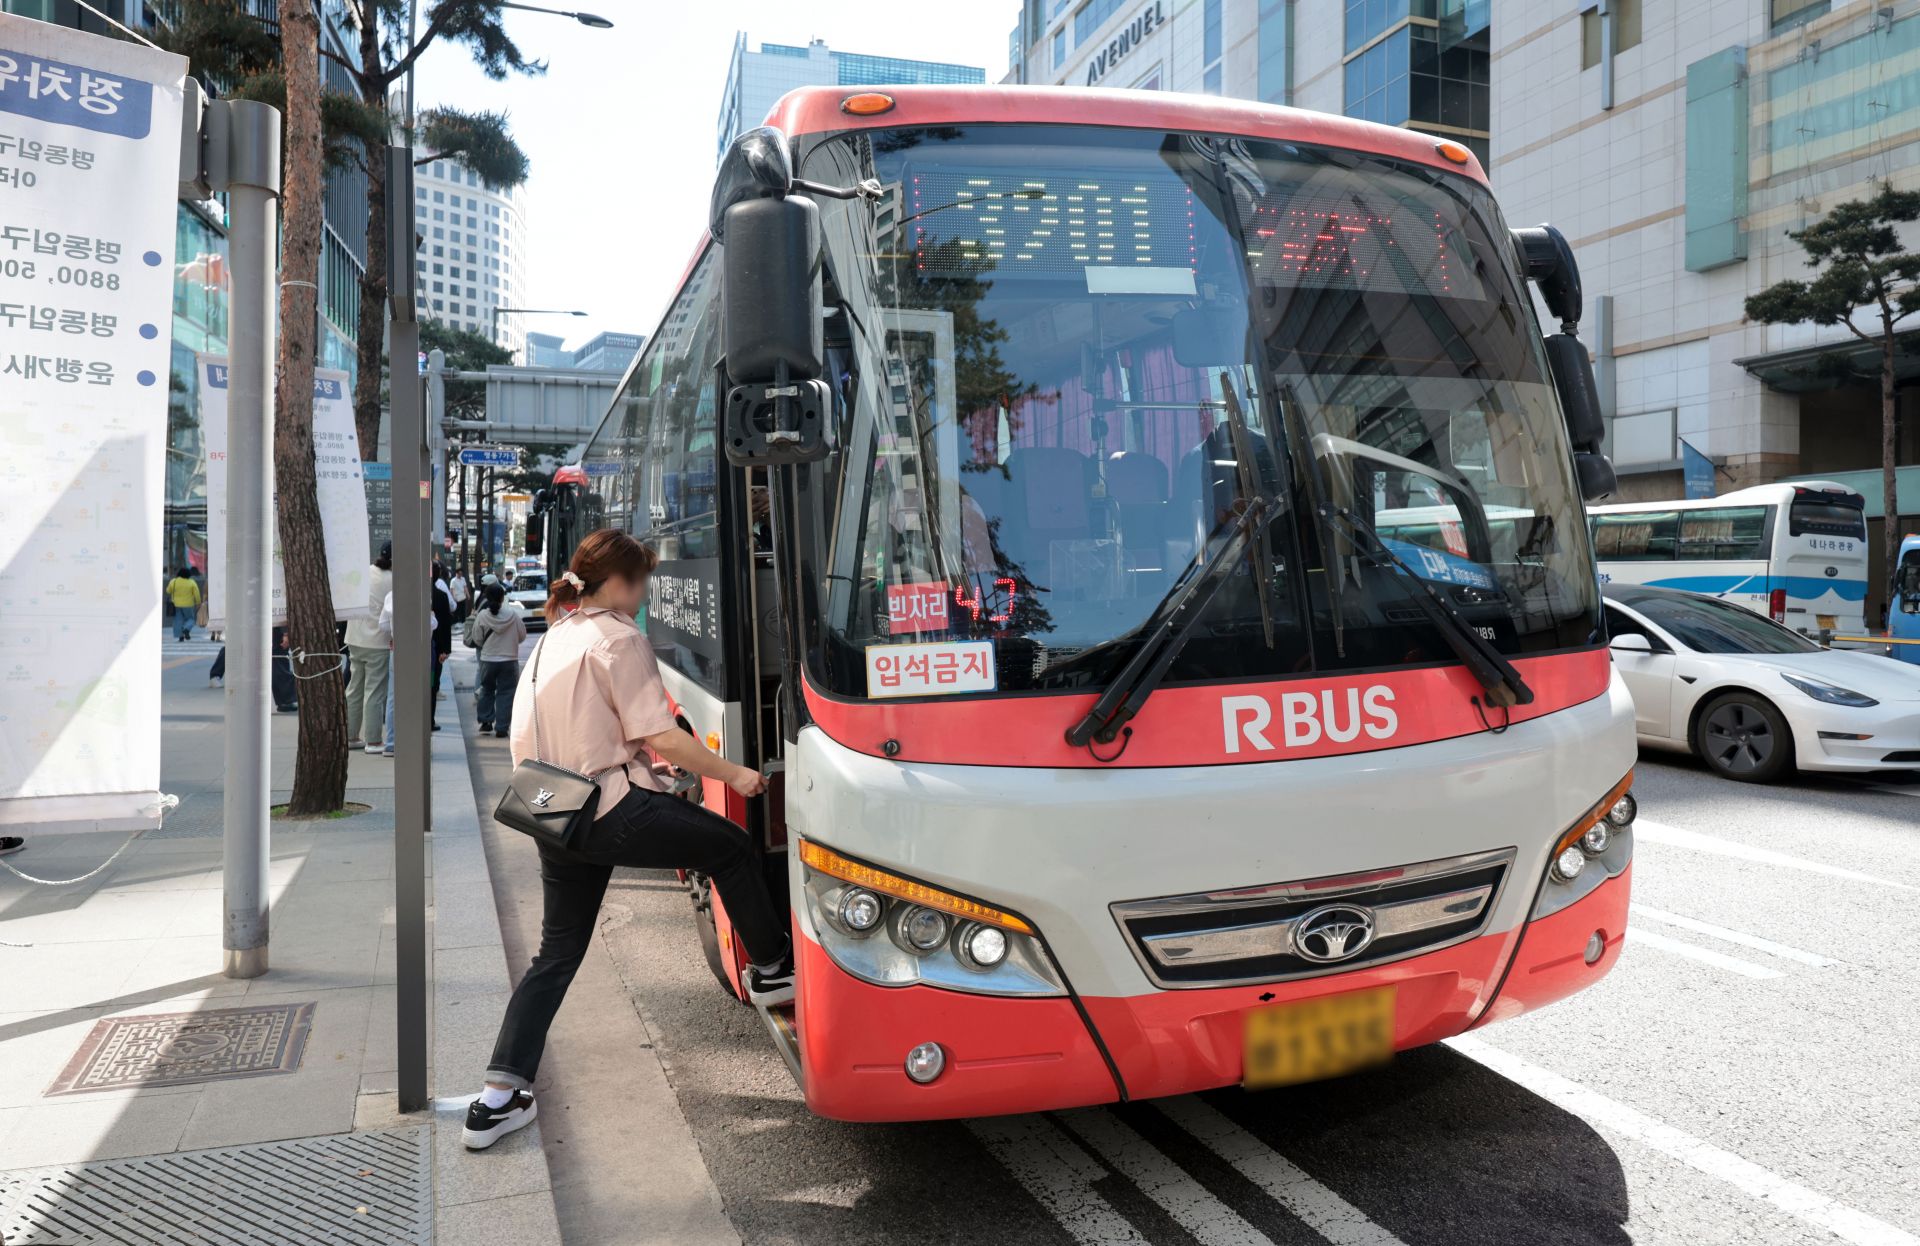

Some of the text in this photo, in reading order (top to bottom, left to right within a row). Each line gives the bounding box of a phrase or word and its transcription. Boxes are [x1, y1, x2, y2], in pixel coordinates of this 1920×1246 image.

[1086, 1, 1165, 87] AVENUEL
[1809, 539, 1854, 552] 내나라관광
[888, 591, 947, 622] 빈자리
[875, 651, 988, 687] 입석금지
